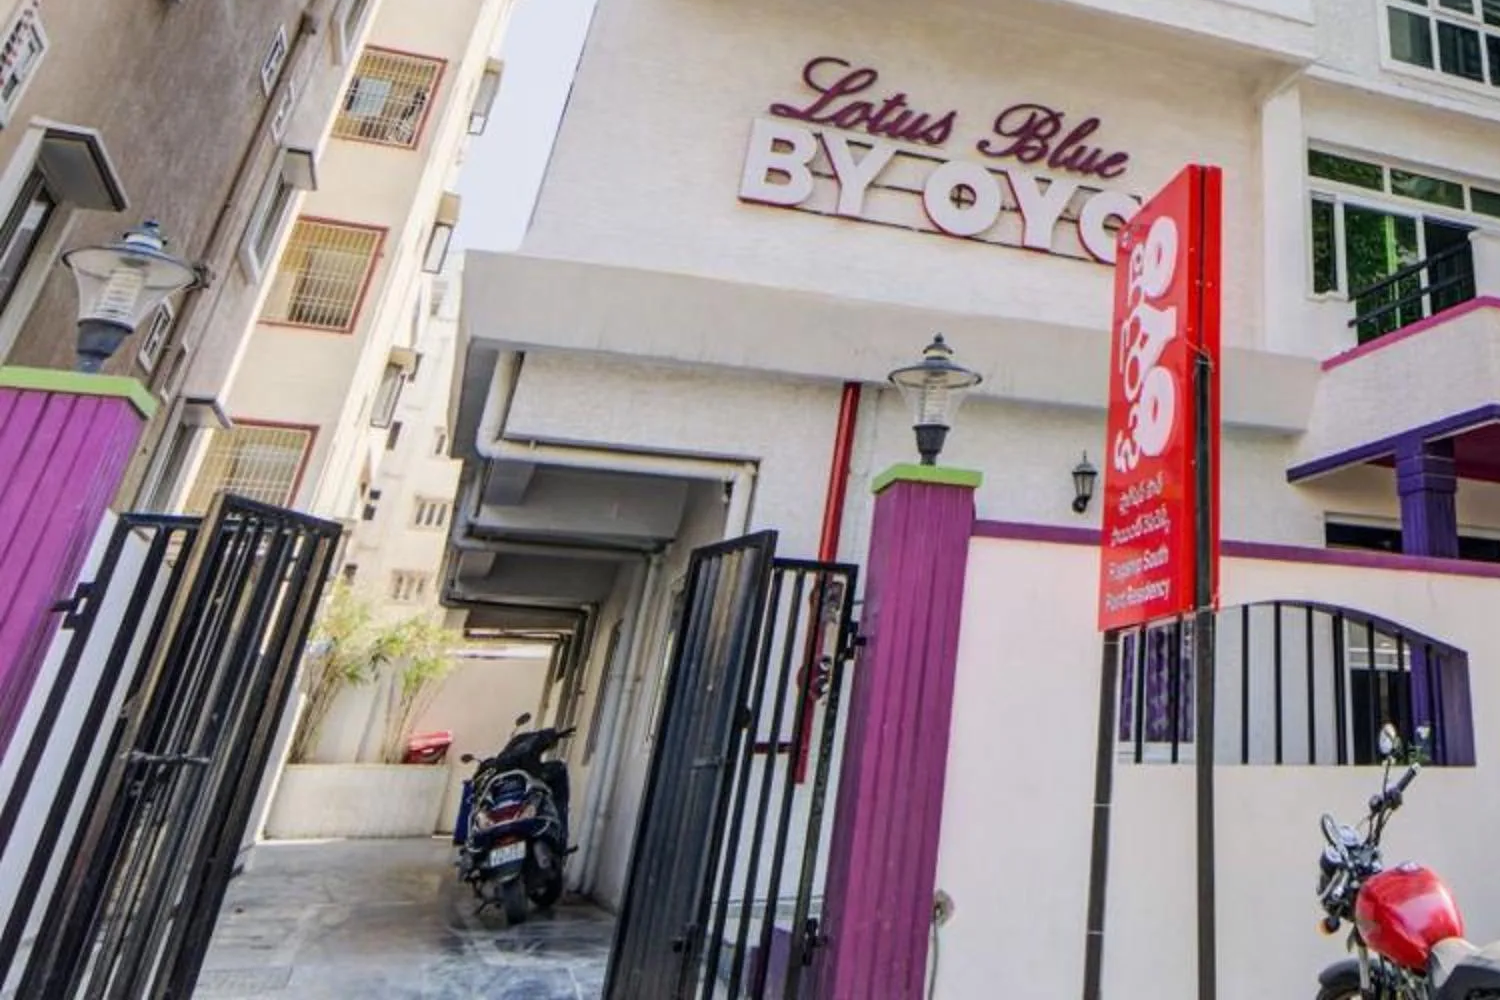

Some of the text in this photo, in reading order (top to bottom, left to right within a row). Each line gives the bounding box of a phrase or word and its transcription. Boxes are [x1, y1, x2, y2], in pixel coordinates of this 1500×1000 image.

[769, 56, 1130, 179] Lotus Blue
[737, 117, 1147, 266] BY OYO
